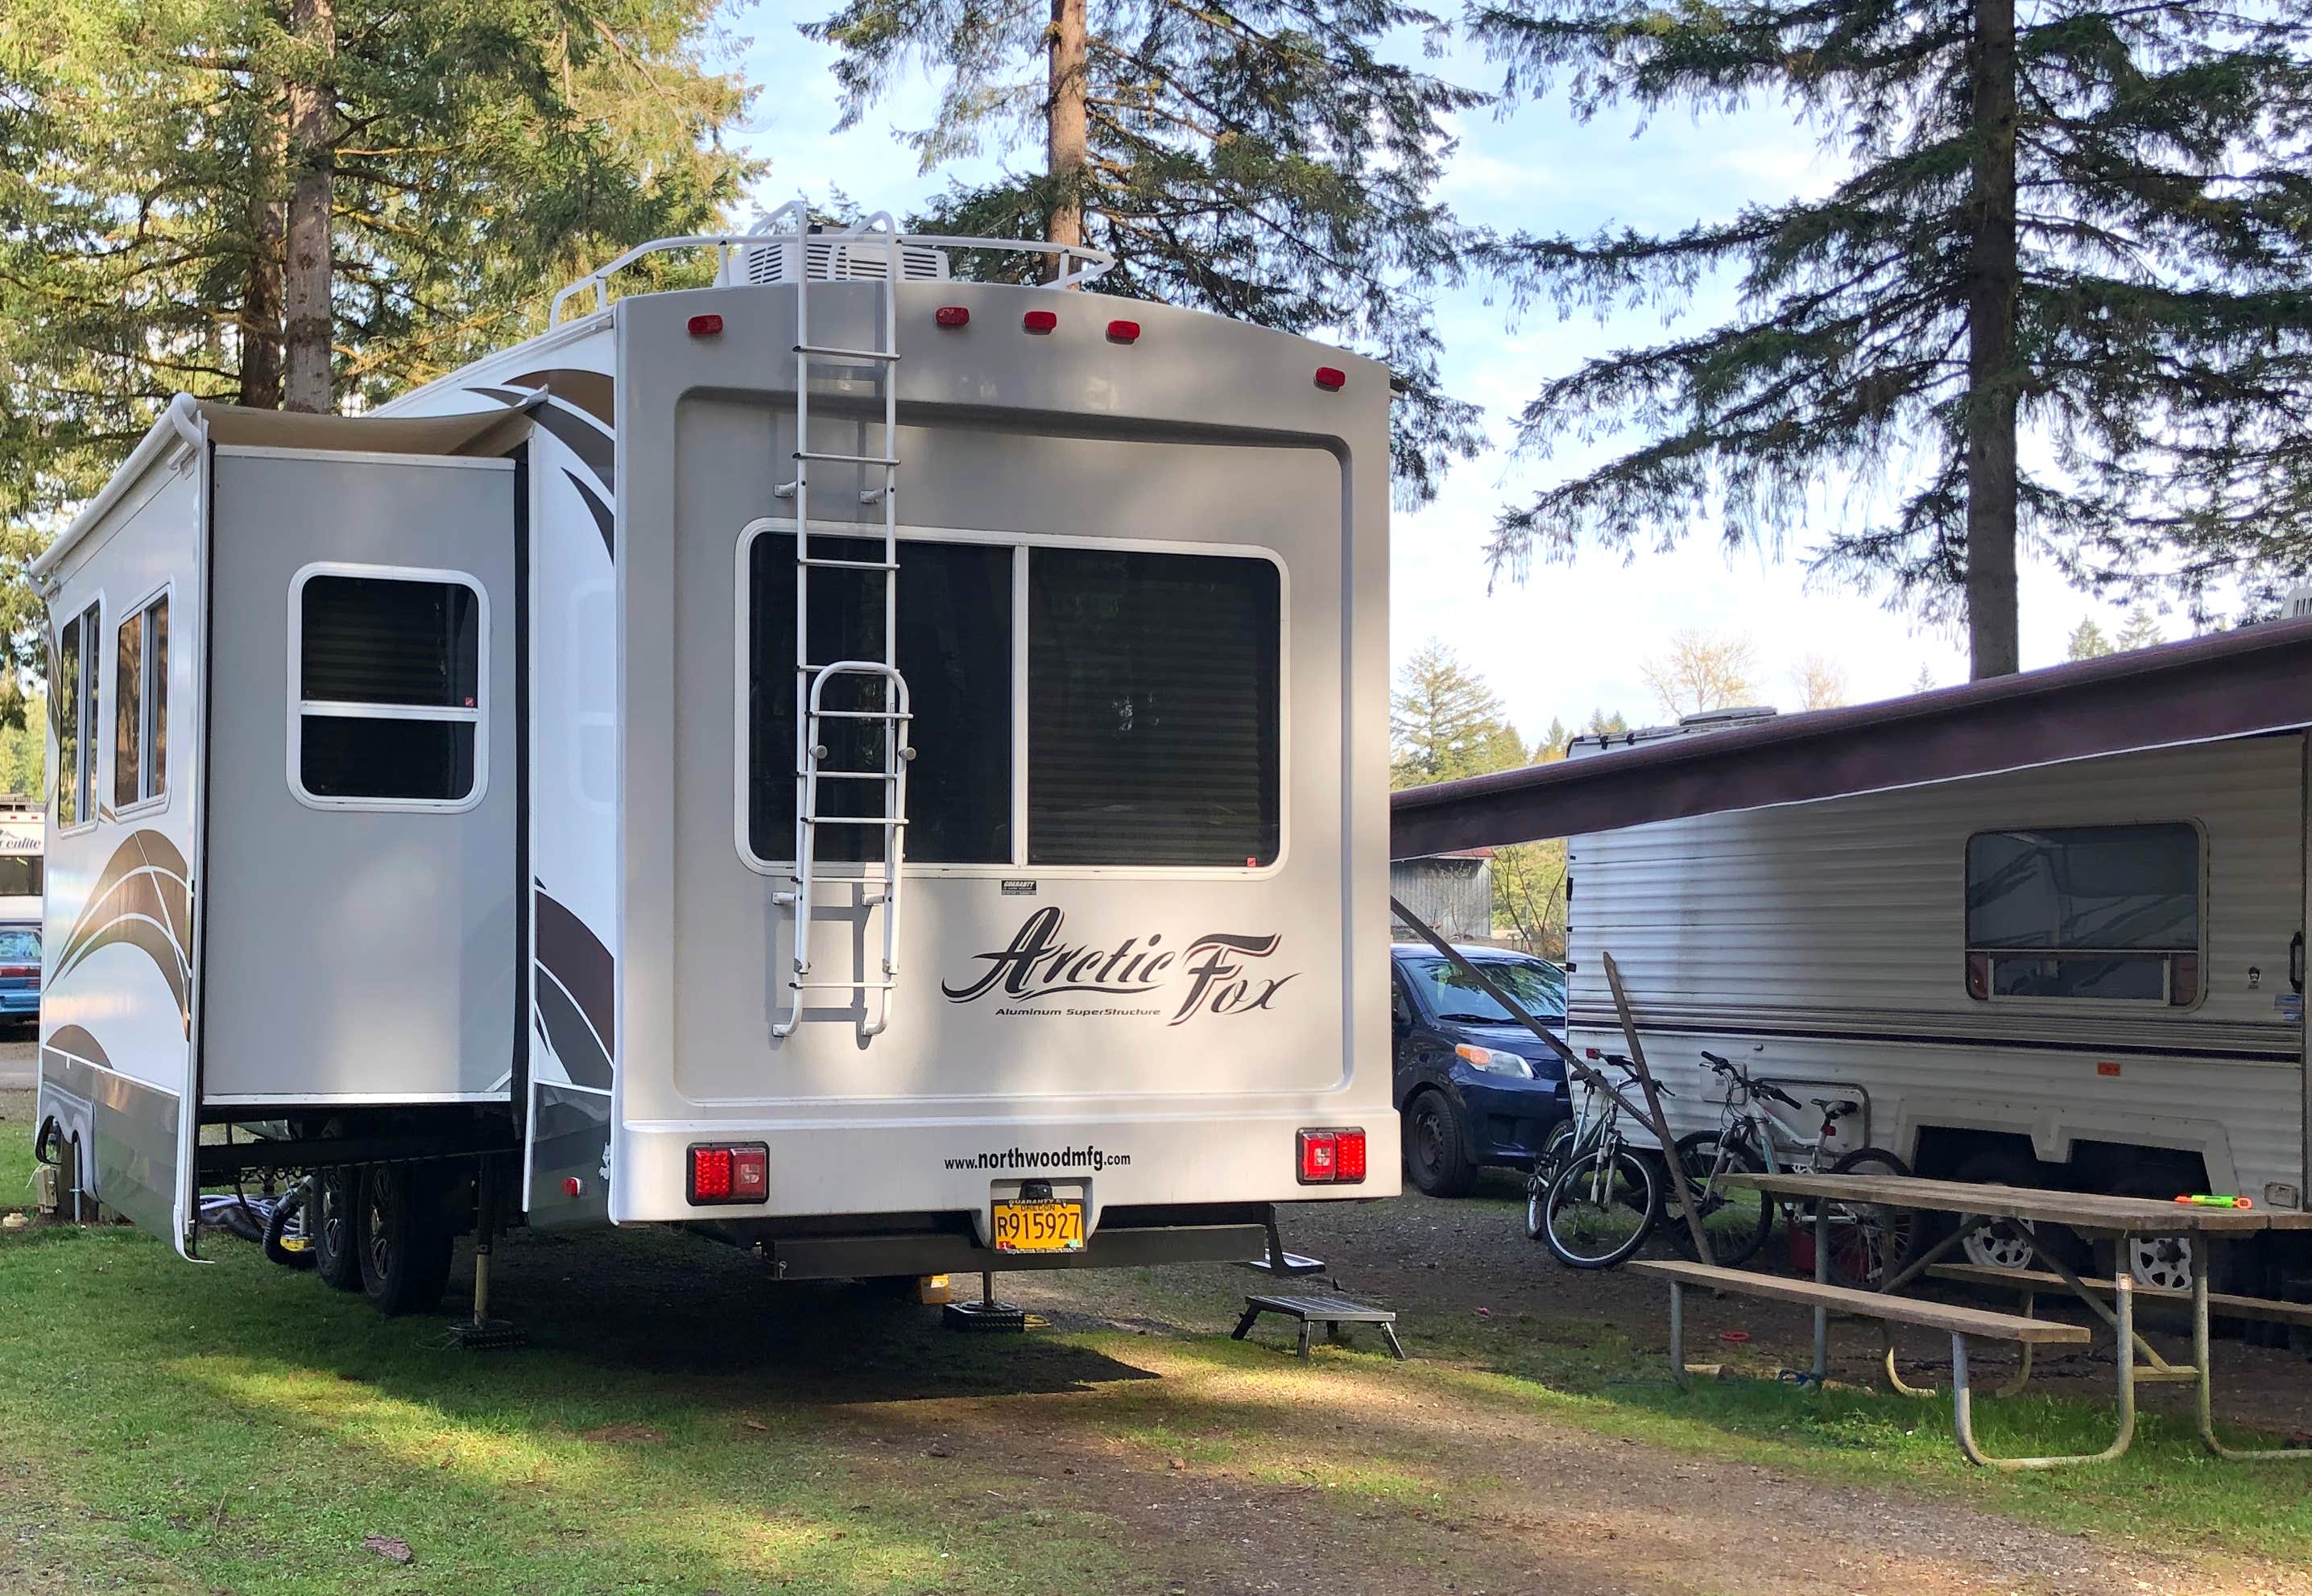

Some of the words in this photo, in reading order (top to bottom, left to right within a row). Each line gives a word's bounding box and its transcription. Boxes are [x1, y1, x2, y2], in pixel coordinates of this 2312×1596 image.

[941, 906, 1179, 1003] Arctic
[1166, 932, 1304, 1027] Fox
[995, 1007, 1062, 1016] Aluminum
[1065, 1007, 1161, 1017] SuperStructure
[944, 1145, 1131, 1172] www.northwoodmfg.com
[1020, 1203, 1056, 1213] OREGON
[998, 1211, 1080, 1240] R915927
